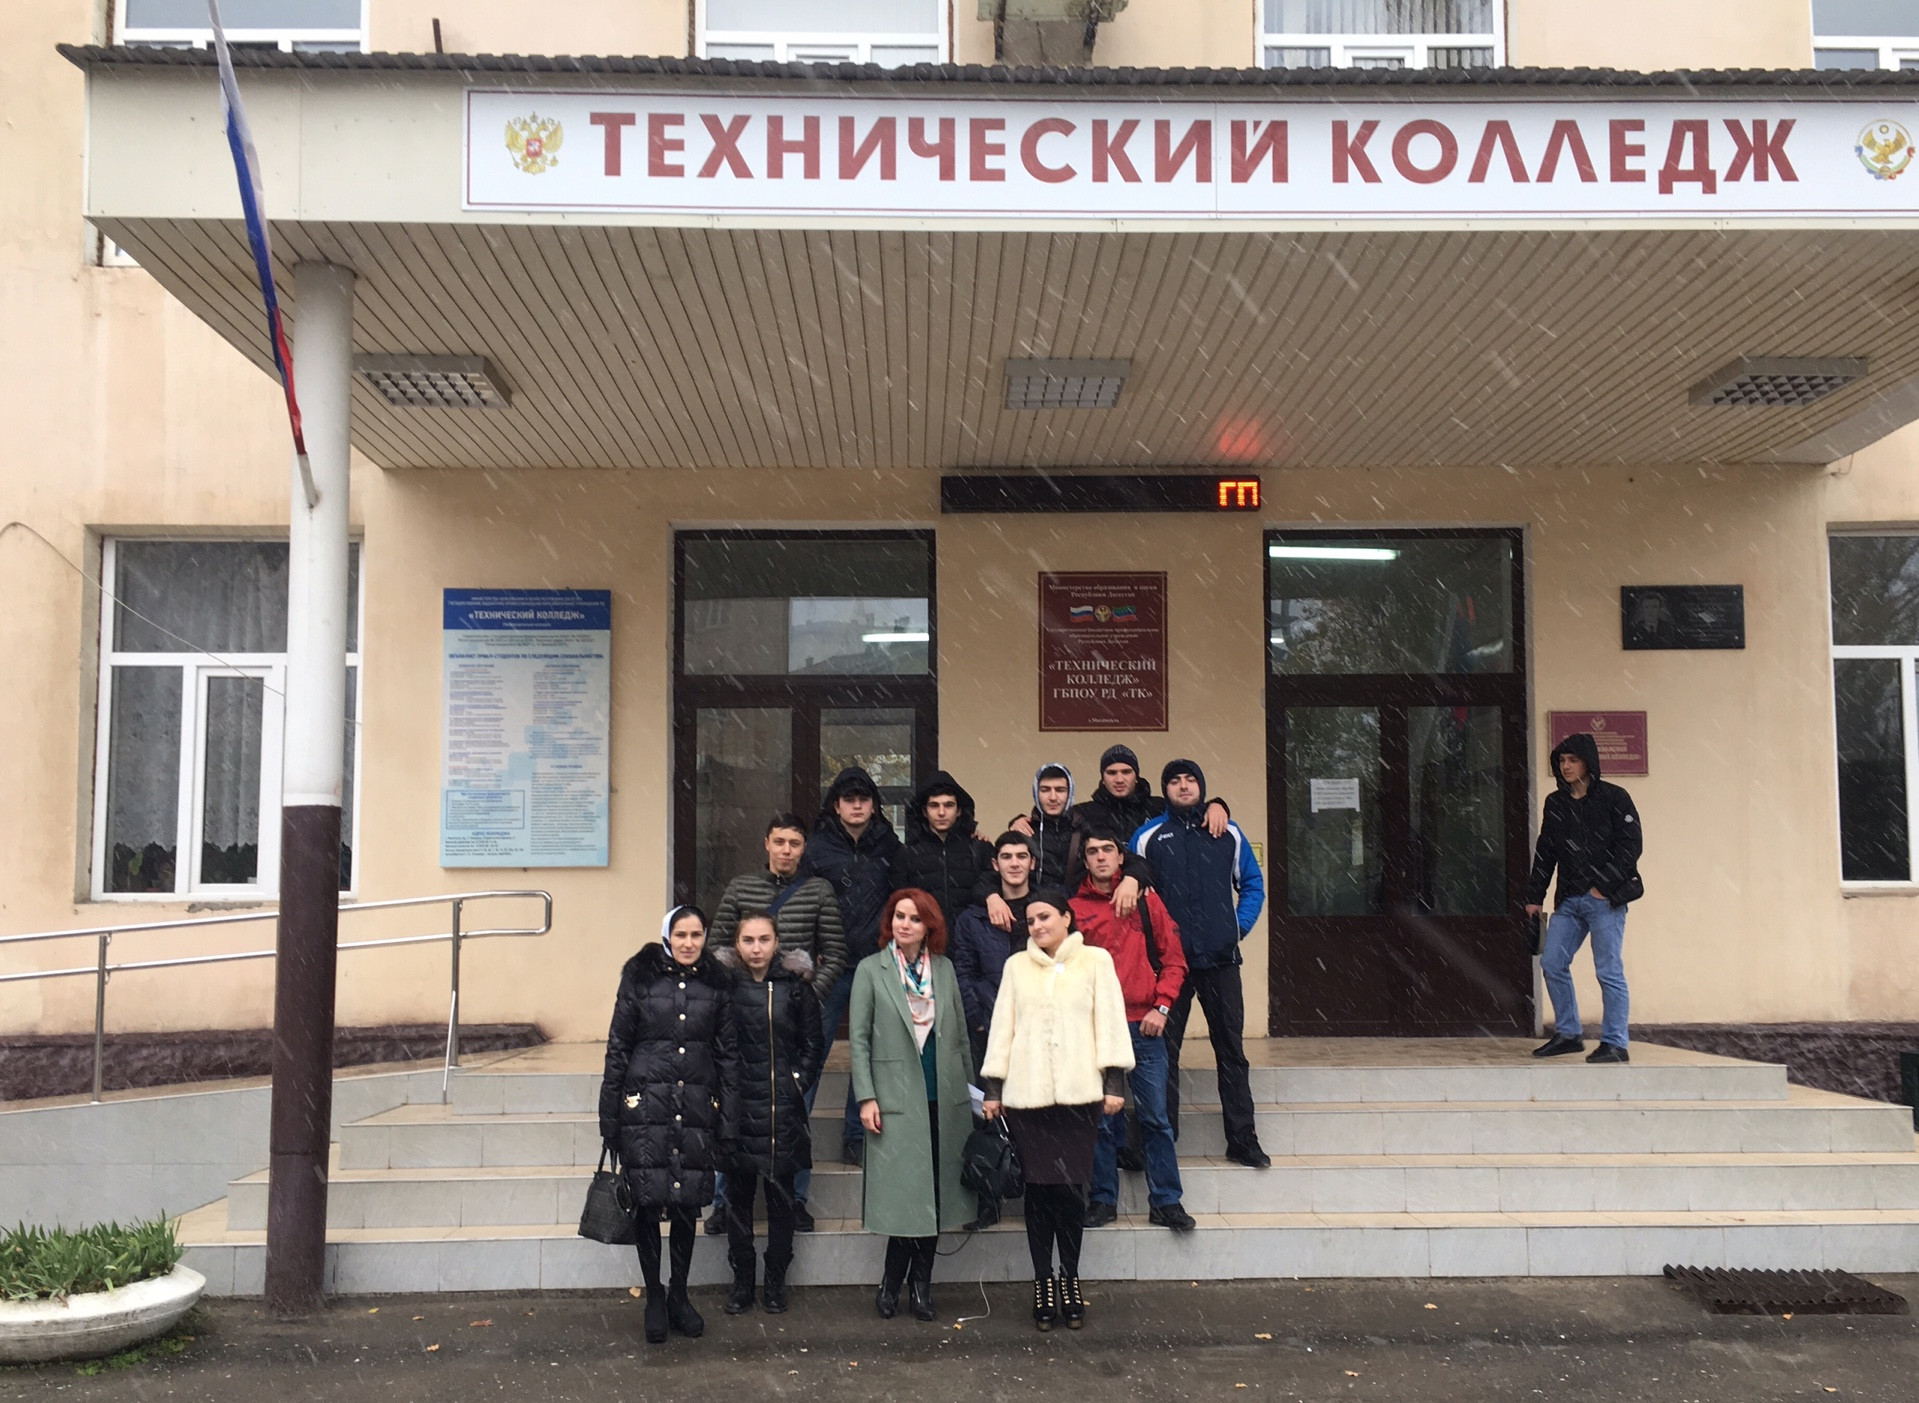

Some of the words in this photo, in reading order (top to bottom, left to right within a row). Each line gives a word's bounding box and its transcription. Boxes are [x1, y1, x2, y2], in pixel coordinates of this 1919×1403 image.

[589, 112, 1289, 184] ТЕХНИЧЕСКИЙ
[1331, 119, 1800, 195] КОЛЛЕДЖ
[468, 609, 534, 620] «ТЕХНИЧЕСКИЙ
[536, 610, 585, 621] КОЛЛЕДЖ»
[1048, 658, 1156, 671] «ТЕХНИЧЕСКИЙ
[1066, 674, 1140, 686] КОЛЛЕДЖ»
[1053, 688, 1098, 699] ГБПОУ
[1101, 688, 1117, 700] РД
[1122, 688, 1153, 699] «ТК»
